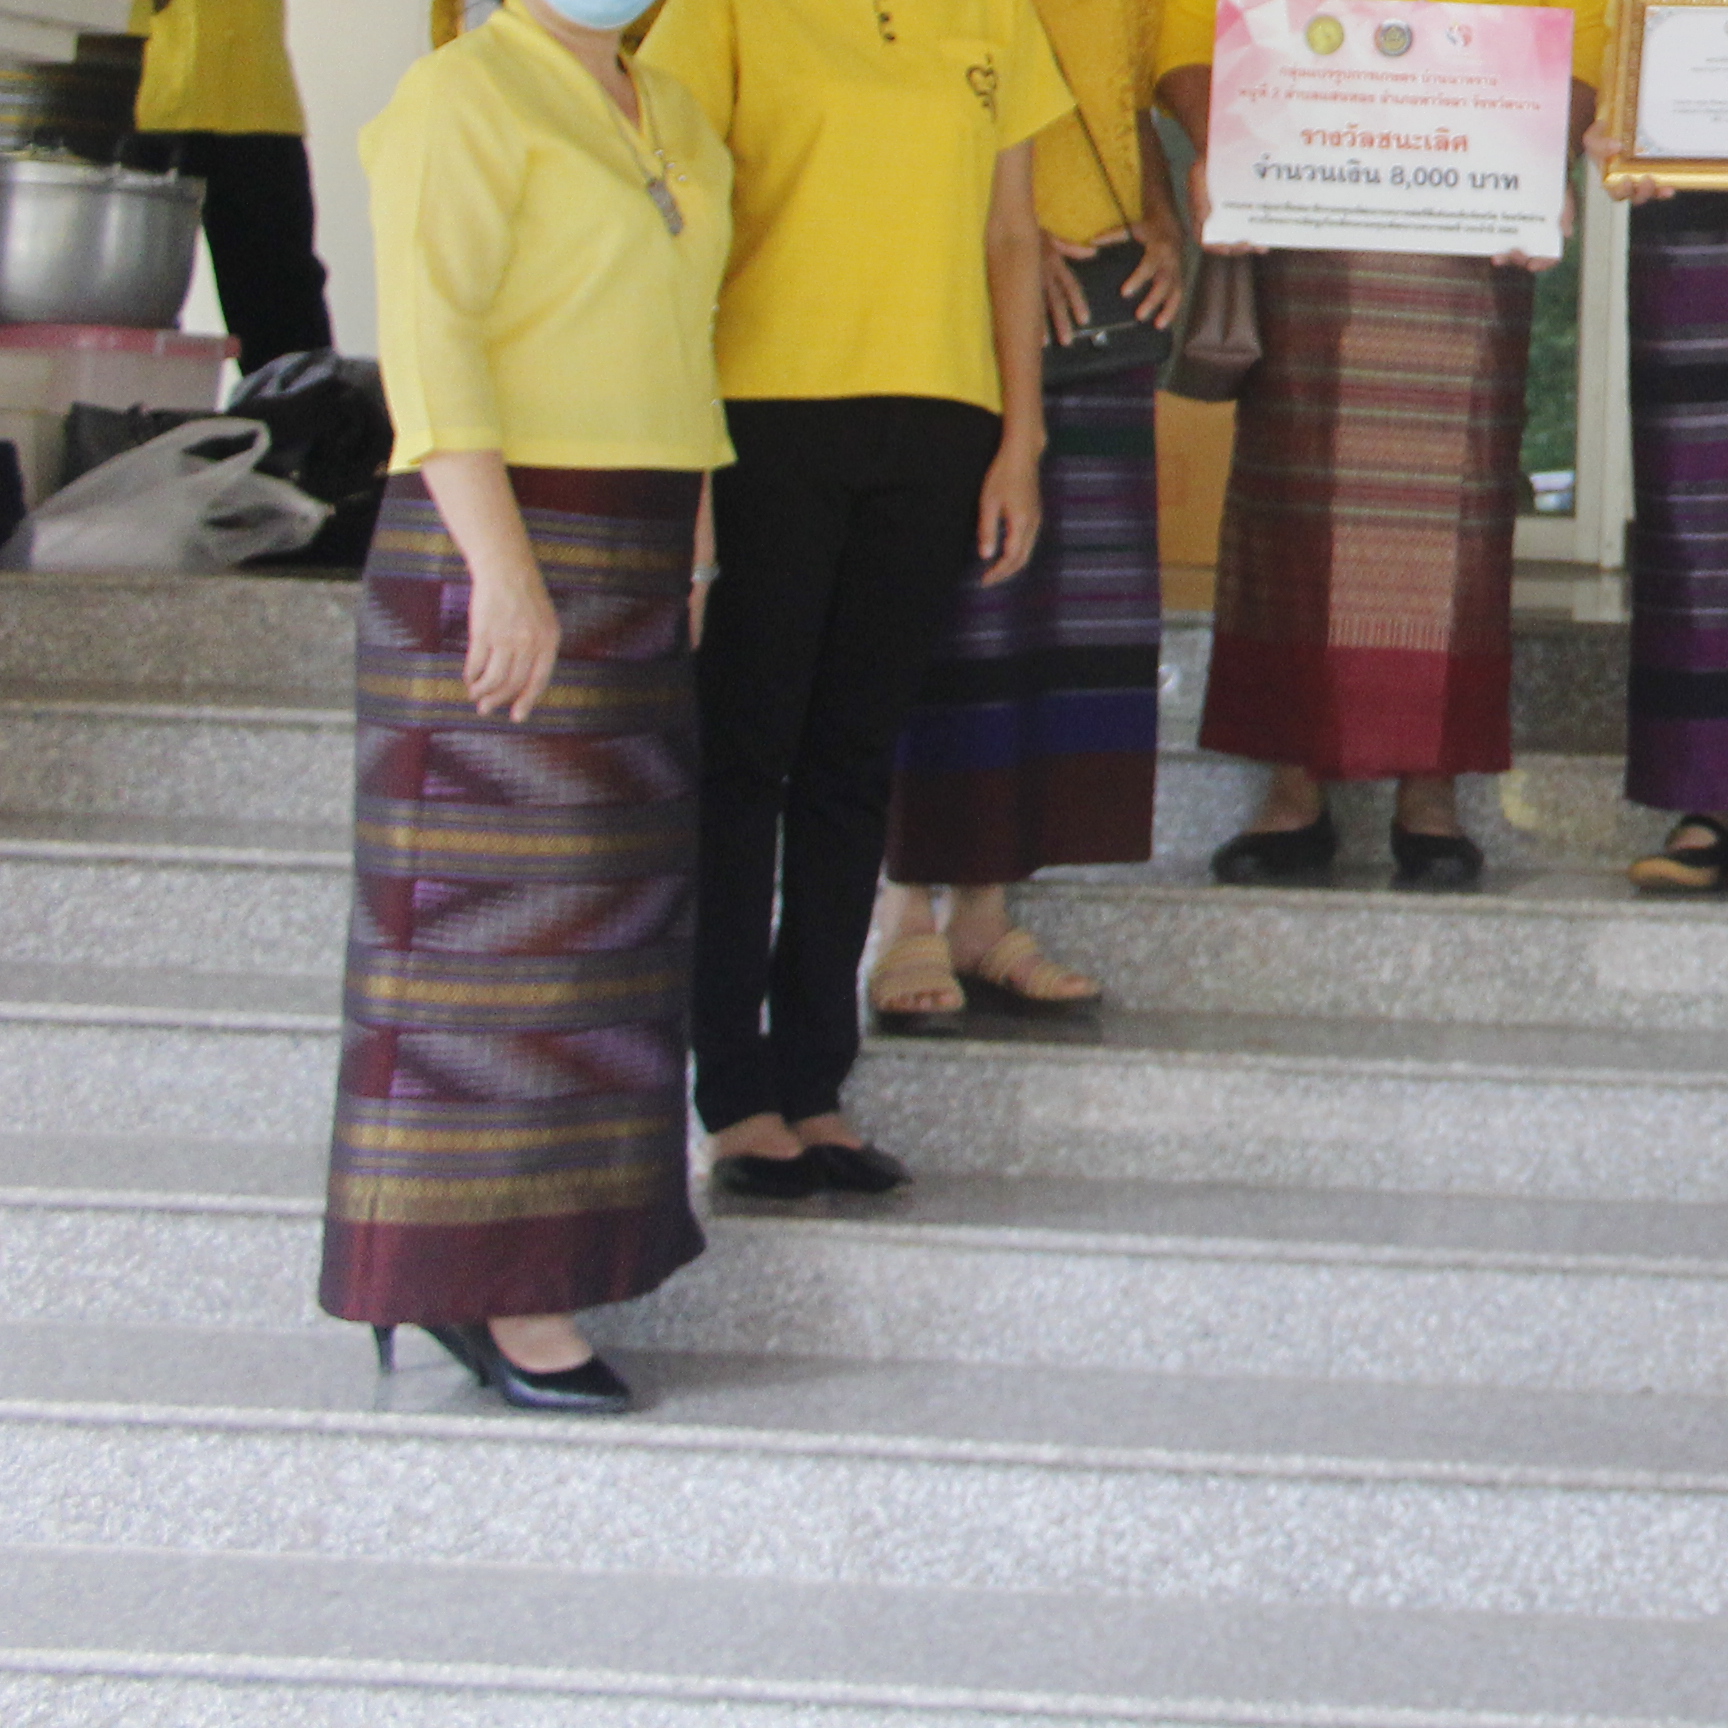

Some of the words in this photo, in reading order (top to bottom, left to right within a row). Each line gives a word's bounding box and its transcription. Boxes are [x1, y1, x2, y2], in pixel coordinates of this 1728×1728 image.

[1301, 123, 1468, 152] รางวัลชนะเลิศ
[1252, 153, 1381, 183] จำนวนเงิน
[1390, 165, 1458, 190] 8,000
[1468, 172, 1519, 190] บาท
